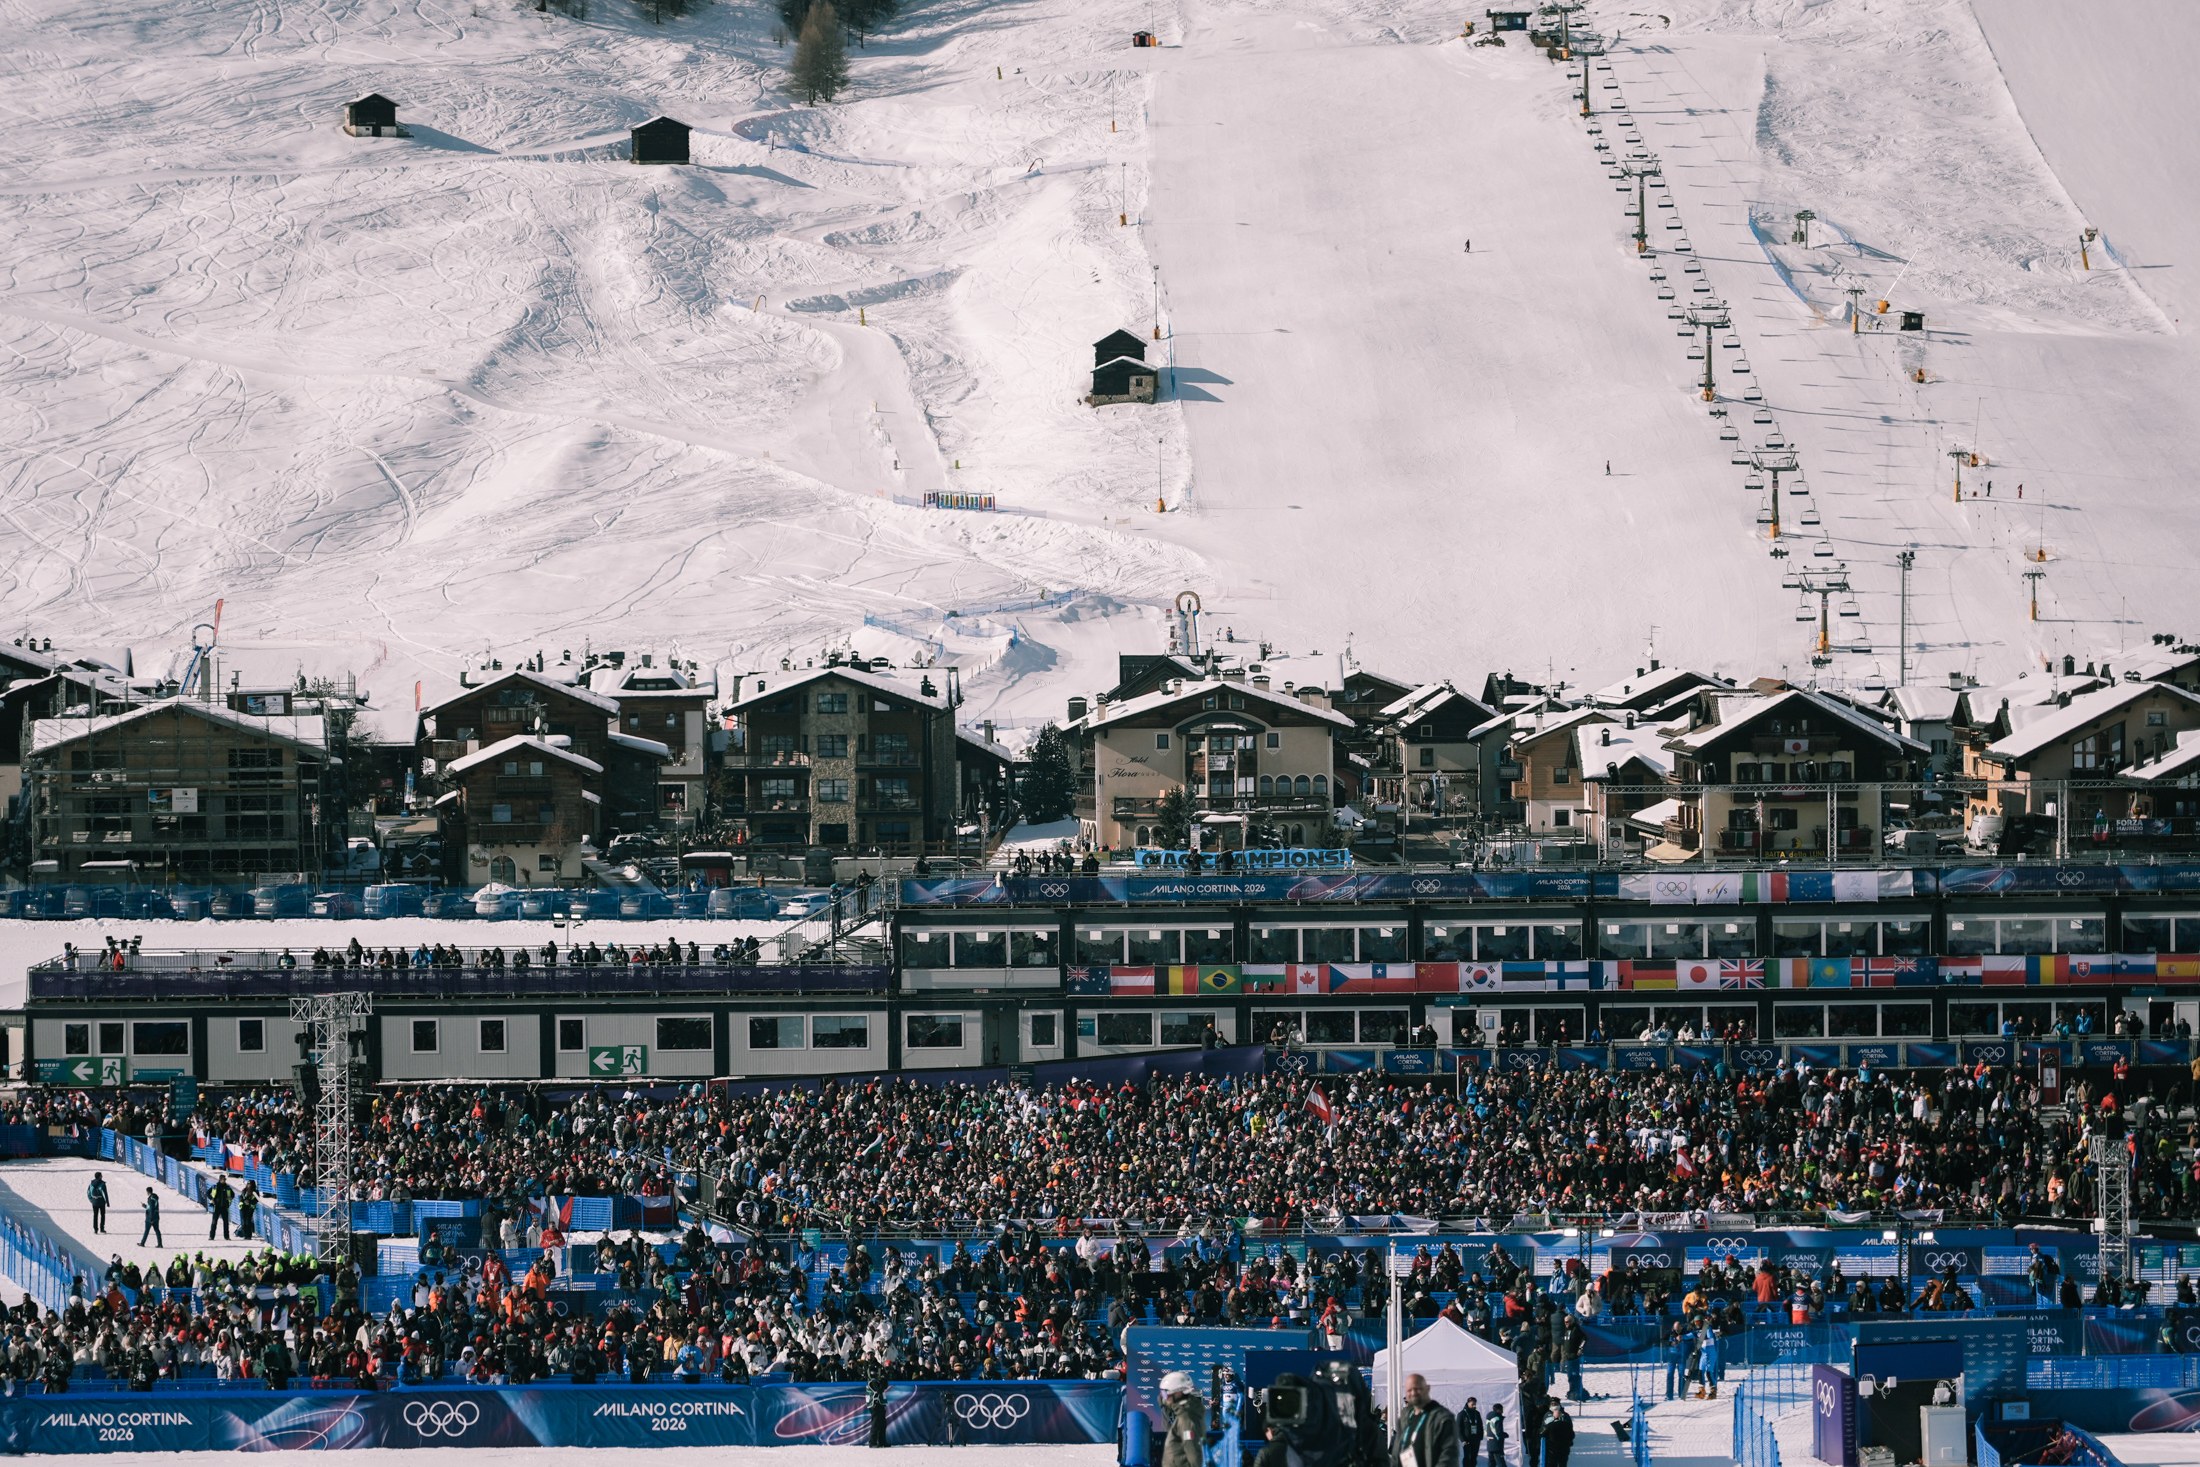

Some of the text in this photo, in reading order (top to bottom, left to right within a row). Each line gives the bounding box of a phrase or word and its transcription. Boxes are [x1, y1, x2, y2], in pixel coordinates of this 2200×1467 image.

[1116, 756, 1149, 765] Hotel
[1108, 768, 1138, 778] Flora
[1204, 850, 1346, 869] CAMPIONS!
[1151, 883, 1266, 893] MILANO CORTINA 2026
[599, 1299, 636, 1307] MILAO
[2032, 1345, 2051, 1353] 2026
[593, 1402, 745, 1416] MILANO CORTINA
[41, 1412, 193, 1427] MILANO CORTINA
[651, 1417, 687, 1431] 2026
[99, 1428, 135, 1441] 2026
